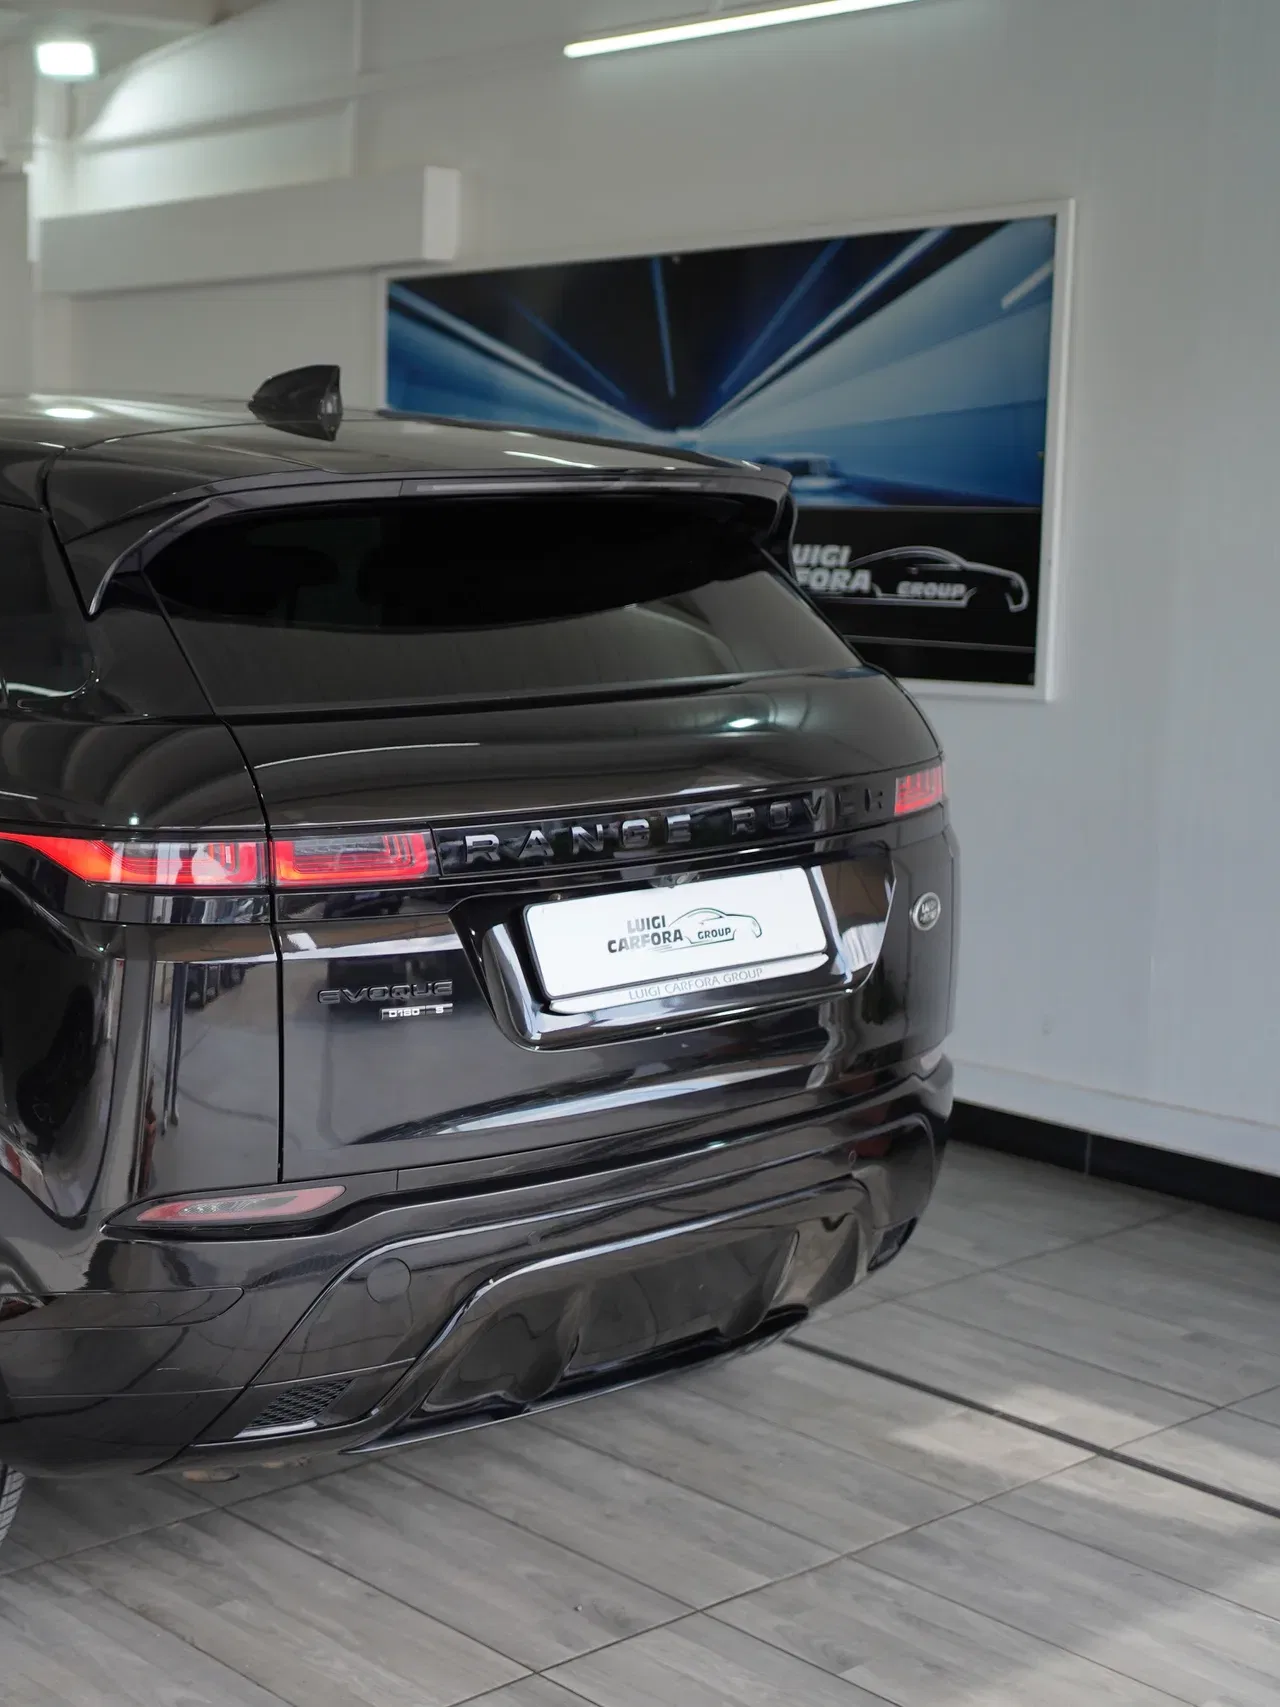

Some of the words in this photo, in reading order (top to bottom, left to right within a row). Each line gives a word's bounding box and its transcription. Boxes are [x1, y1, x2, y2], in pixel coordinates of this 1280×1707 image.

[792, 544, 851, 567] UIGI
[796, 567, 871, 593] FORA
[896, 582, 968, 599] GROUP
[464, 813, 692, 865] RANGE
[627, 915, 666, 934] LUIGI
[607, 929, 684, 954] CARFORA
[697, 927, 732, 940] GROUP
[318, 980, 453, 1005] EVOQUE
[629, 986, 661, 1001] LUIGI
[664, 975, 720, 993] CARFORA
[723, 967, 763, 983] GROUP
[435, 1006, 444, 1014] S
